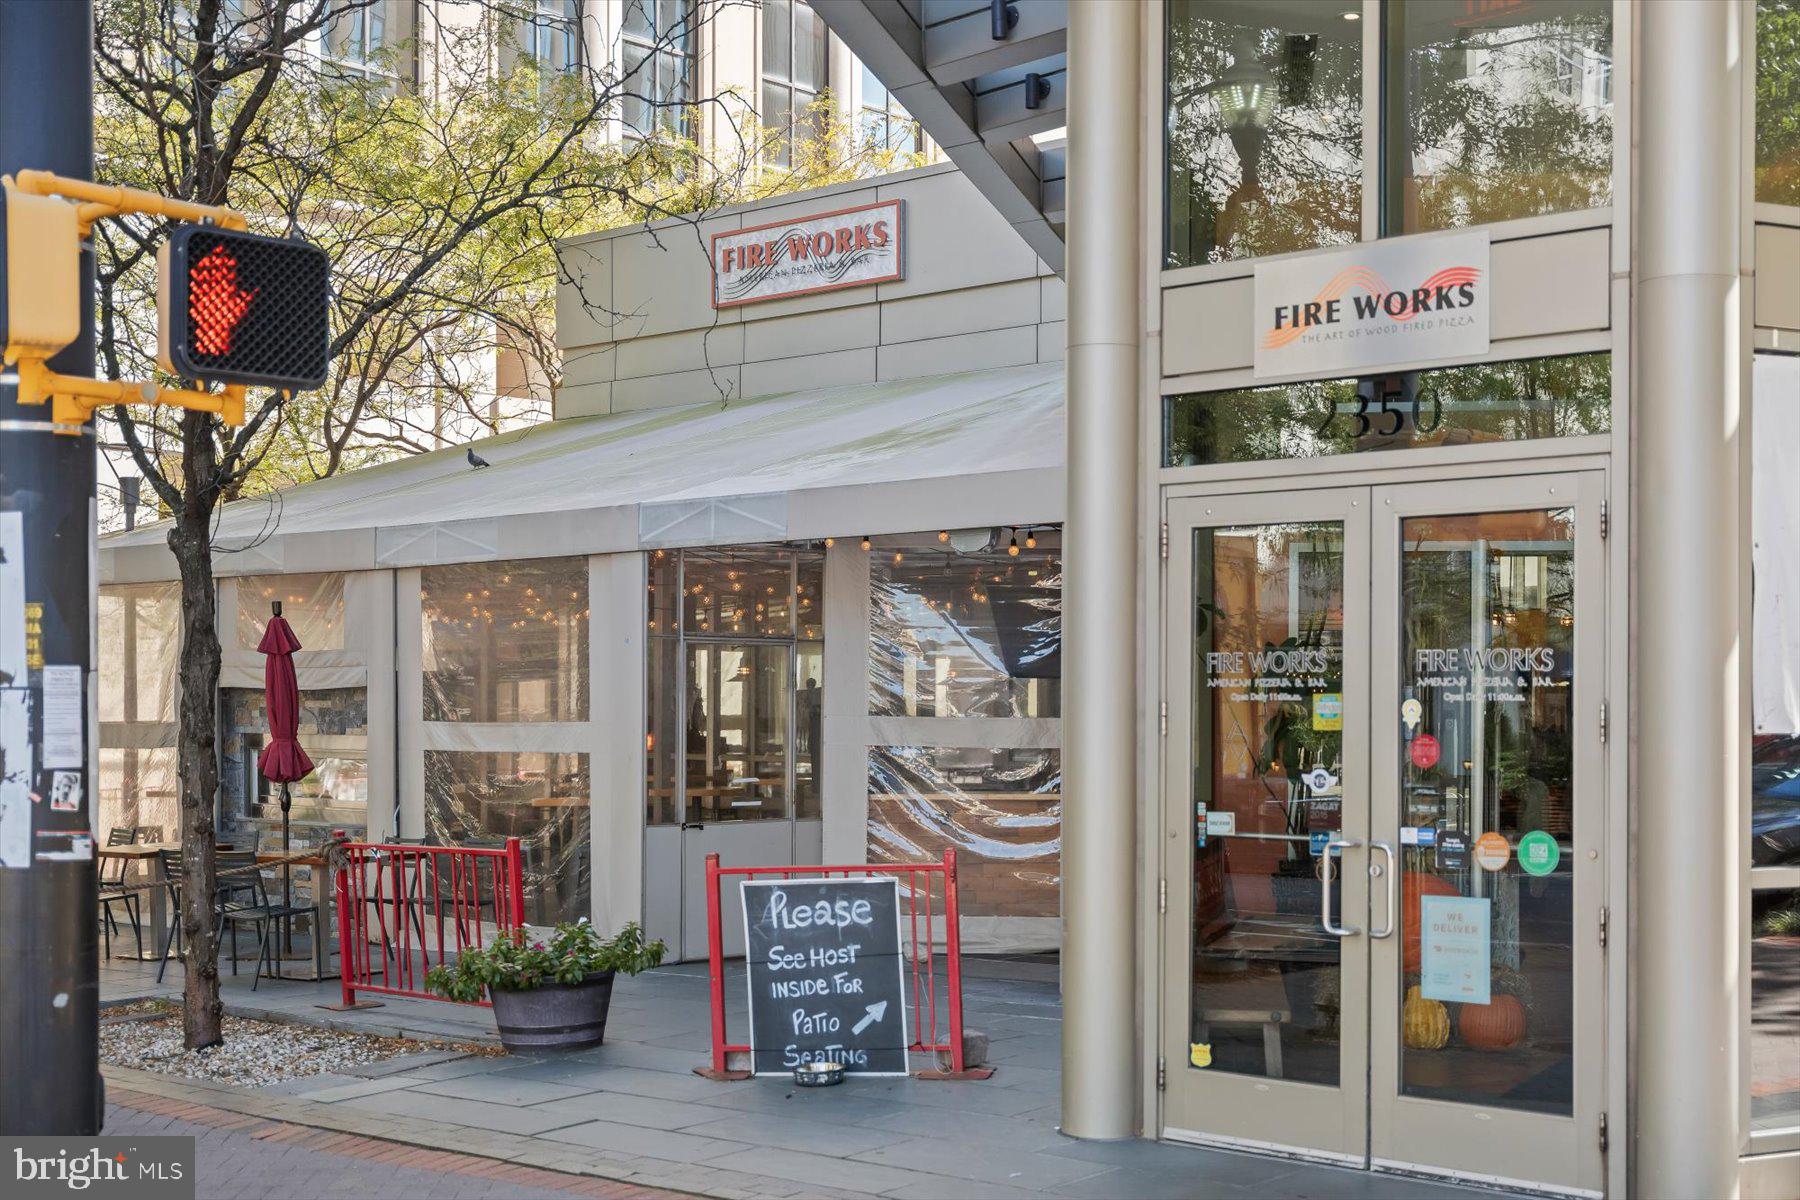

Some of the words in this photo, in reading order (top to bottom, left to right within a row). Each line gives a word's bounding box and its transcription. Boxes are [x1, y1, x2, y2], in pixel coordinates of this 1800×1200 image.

[722, 240, 779, 273] FIRE
[787, 220, 889, 261] WORKS
[1274, 299, 1341, 330] FIRE
[1353, 282, 1475, 320] WORKS
[1302, 335, 1321, 344] THE
[1325, 332, 1343, 343] ART
[1349, 329, 1362, 338] OF
[1364, 325, 1398, 337] WOOD
[1402, 321, 1433, 333] FIRED
[1439, 316, 1474, 328] PIZZA
[1318, 387, 1442, 439] 2350
[1206, 652, 1244, 673] FIRE
[1248, 650, 1328, 673] WORKS
[1416, 648, 1459, 672] FIRE
[1463, 647, 1555, 672] WORKS
[1443, 692, 1465, 703] Open
[1310, 802, 1340, 811] ZAGAT
[1433, 923, 1478, 935] DELIVER
[1446, 912, 1464, 921] WE
[767, 945, 807, 971] See
